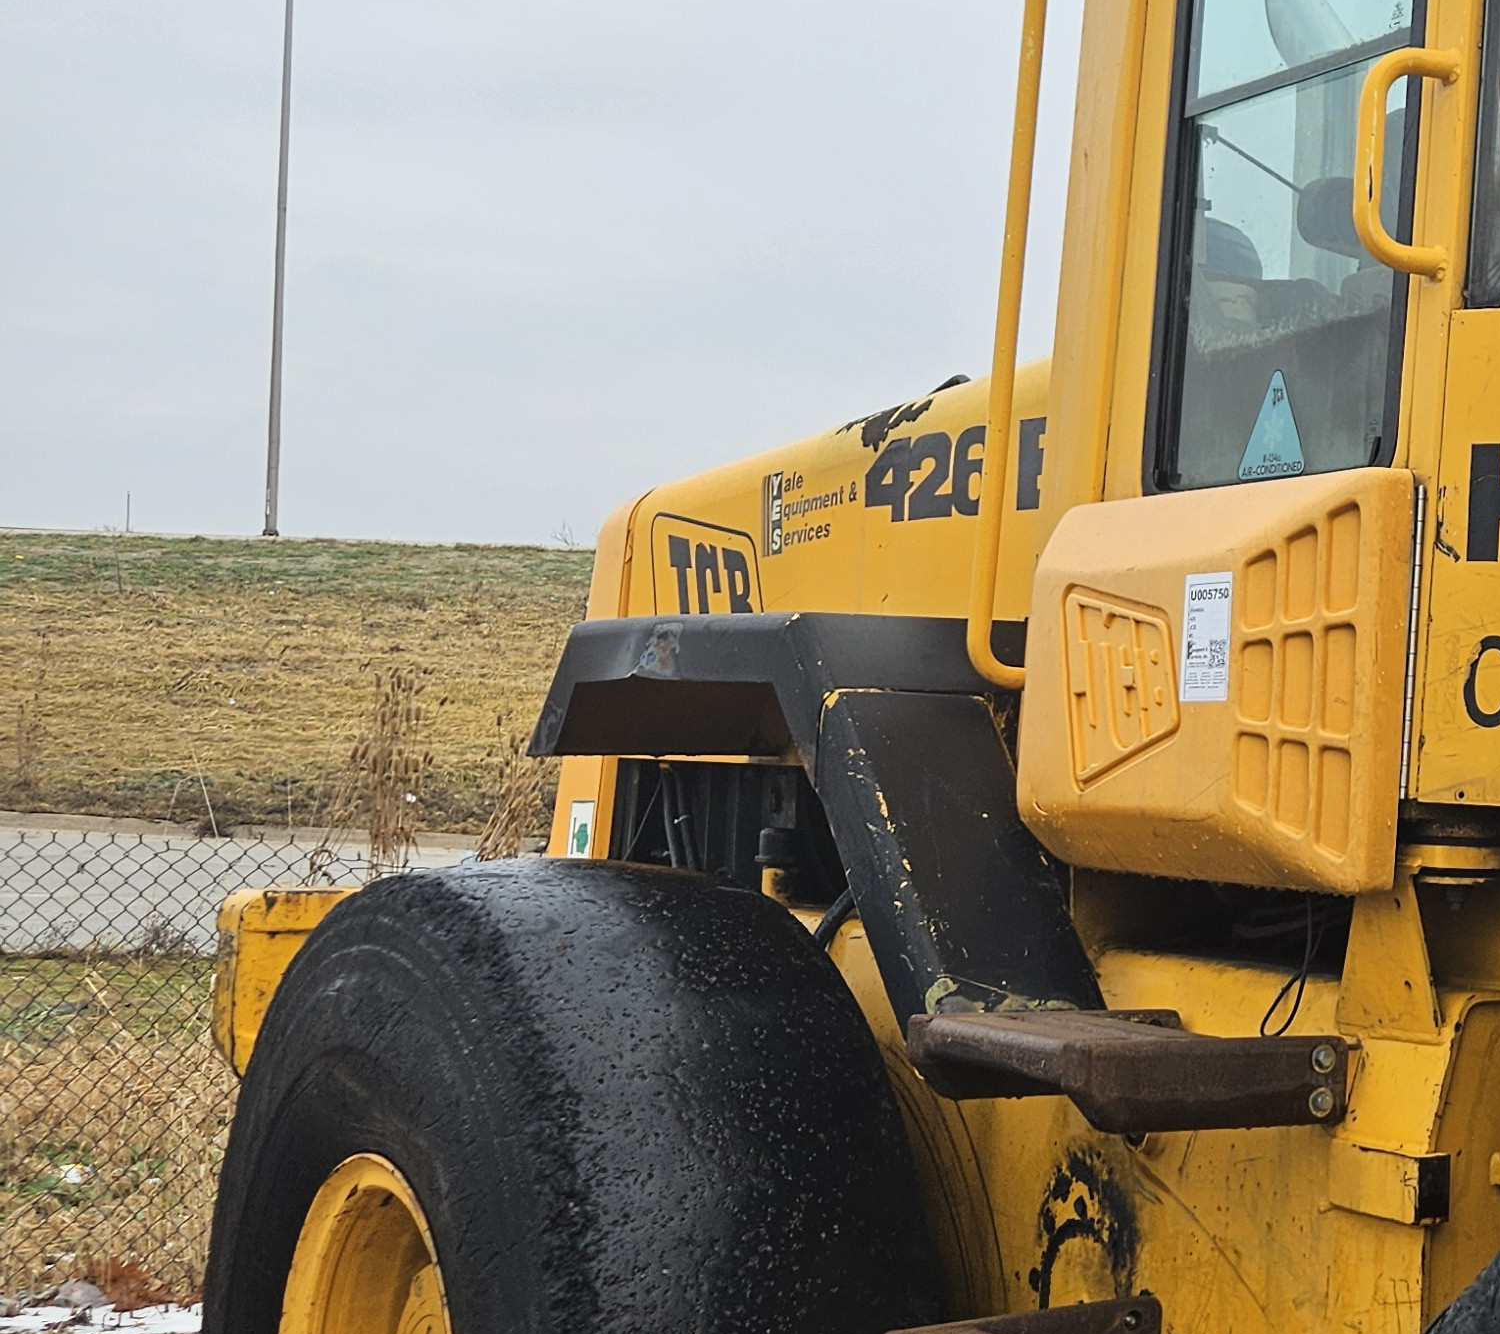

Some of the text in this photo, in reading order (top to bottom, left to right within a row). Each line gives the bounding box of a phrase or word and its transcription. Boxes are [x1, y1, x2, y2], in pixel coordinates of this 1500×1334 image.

[771, 471, 804, 497] Yale
[771, 480, 858, 522] Equipment &
[771, 523, 831, 552] Services
[1190, 587, 1230, 601] U005750
